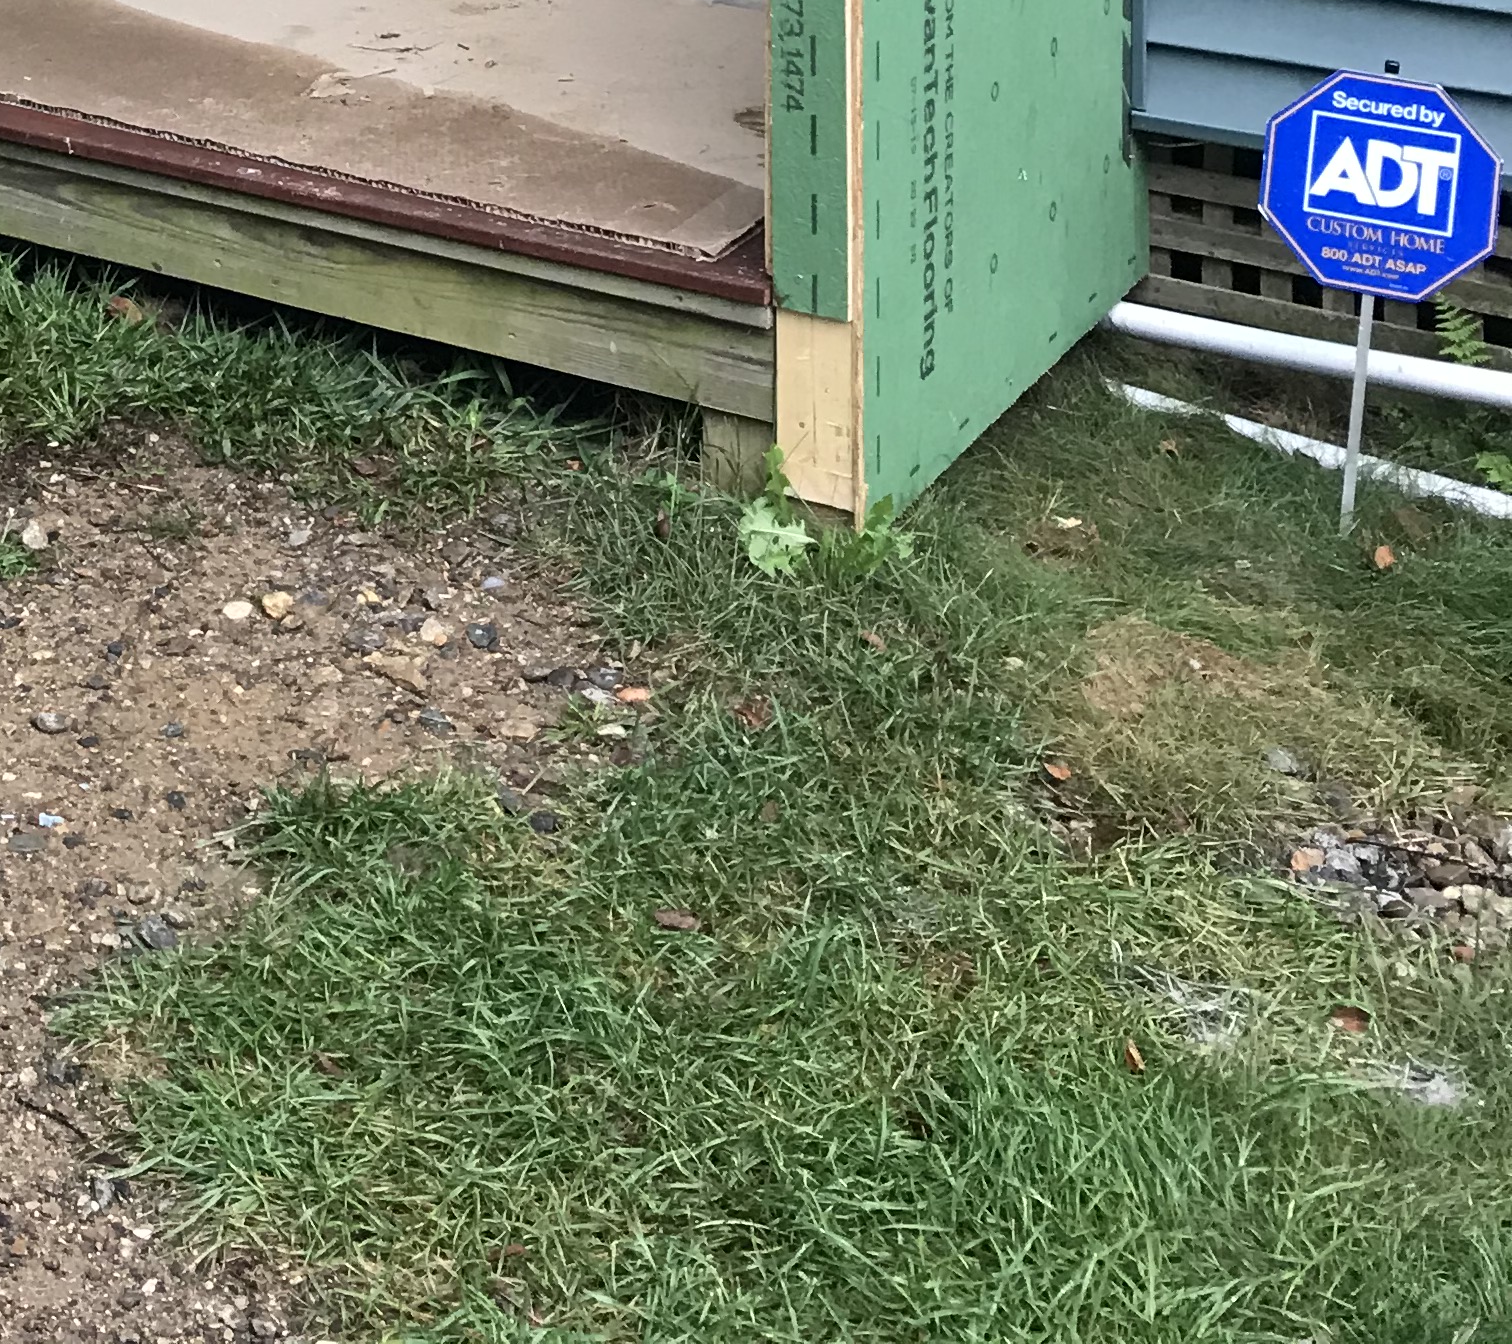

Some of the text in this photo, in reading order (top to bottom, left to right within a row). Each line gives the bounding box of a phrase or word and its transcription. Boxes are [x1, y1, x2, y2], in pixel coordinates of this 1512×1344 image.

[945, 50, 955, 103] THE
[1332, 90, 1446, 128] Secured by
[945, 111, 955, 269] CREATORS
[1309, 136, 1456, 216] ADT
[1306, 215, 1445, 255] CUSTOM HOME
[1321, 246, 1427, 275] 800 ADT ASAP
[945, 278, 955, 315] OF
